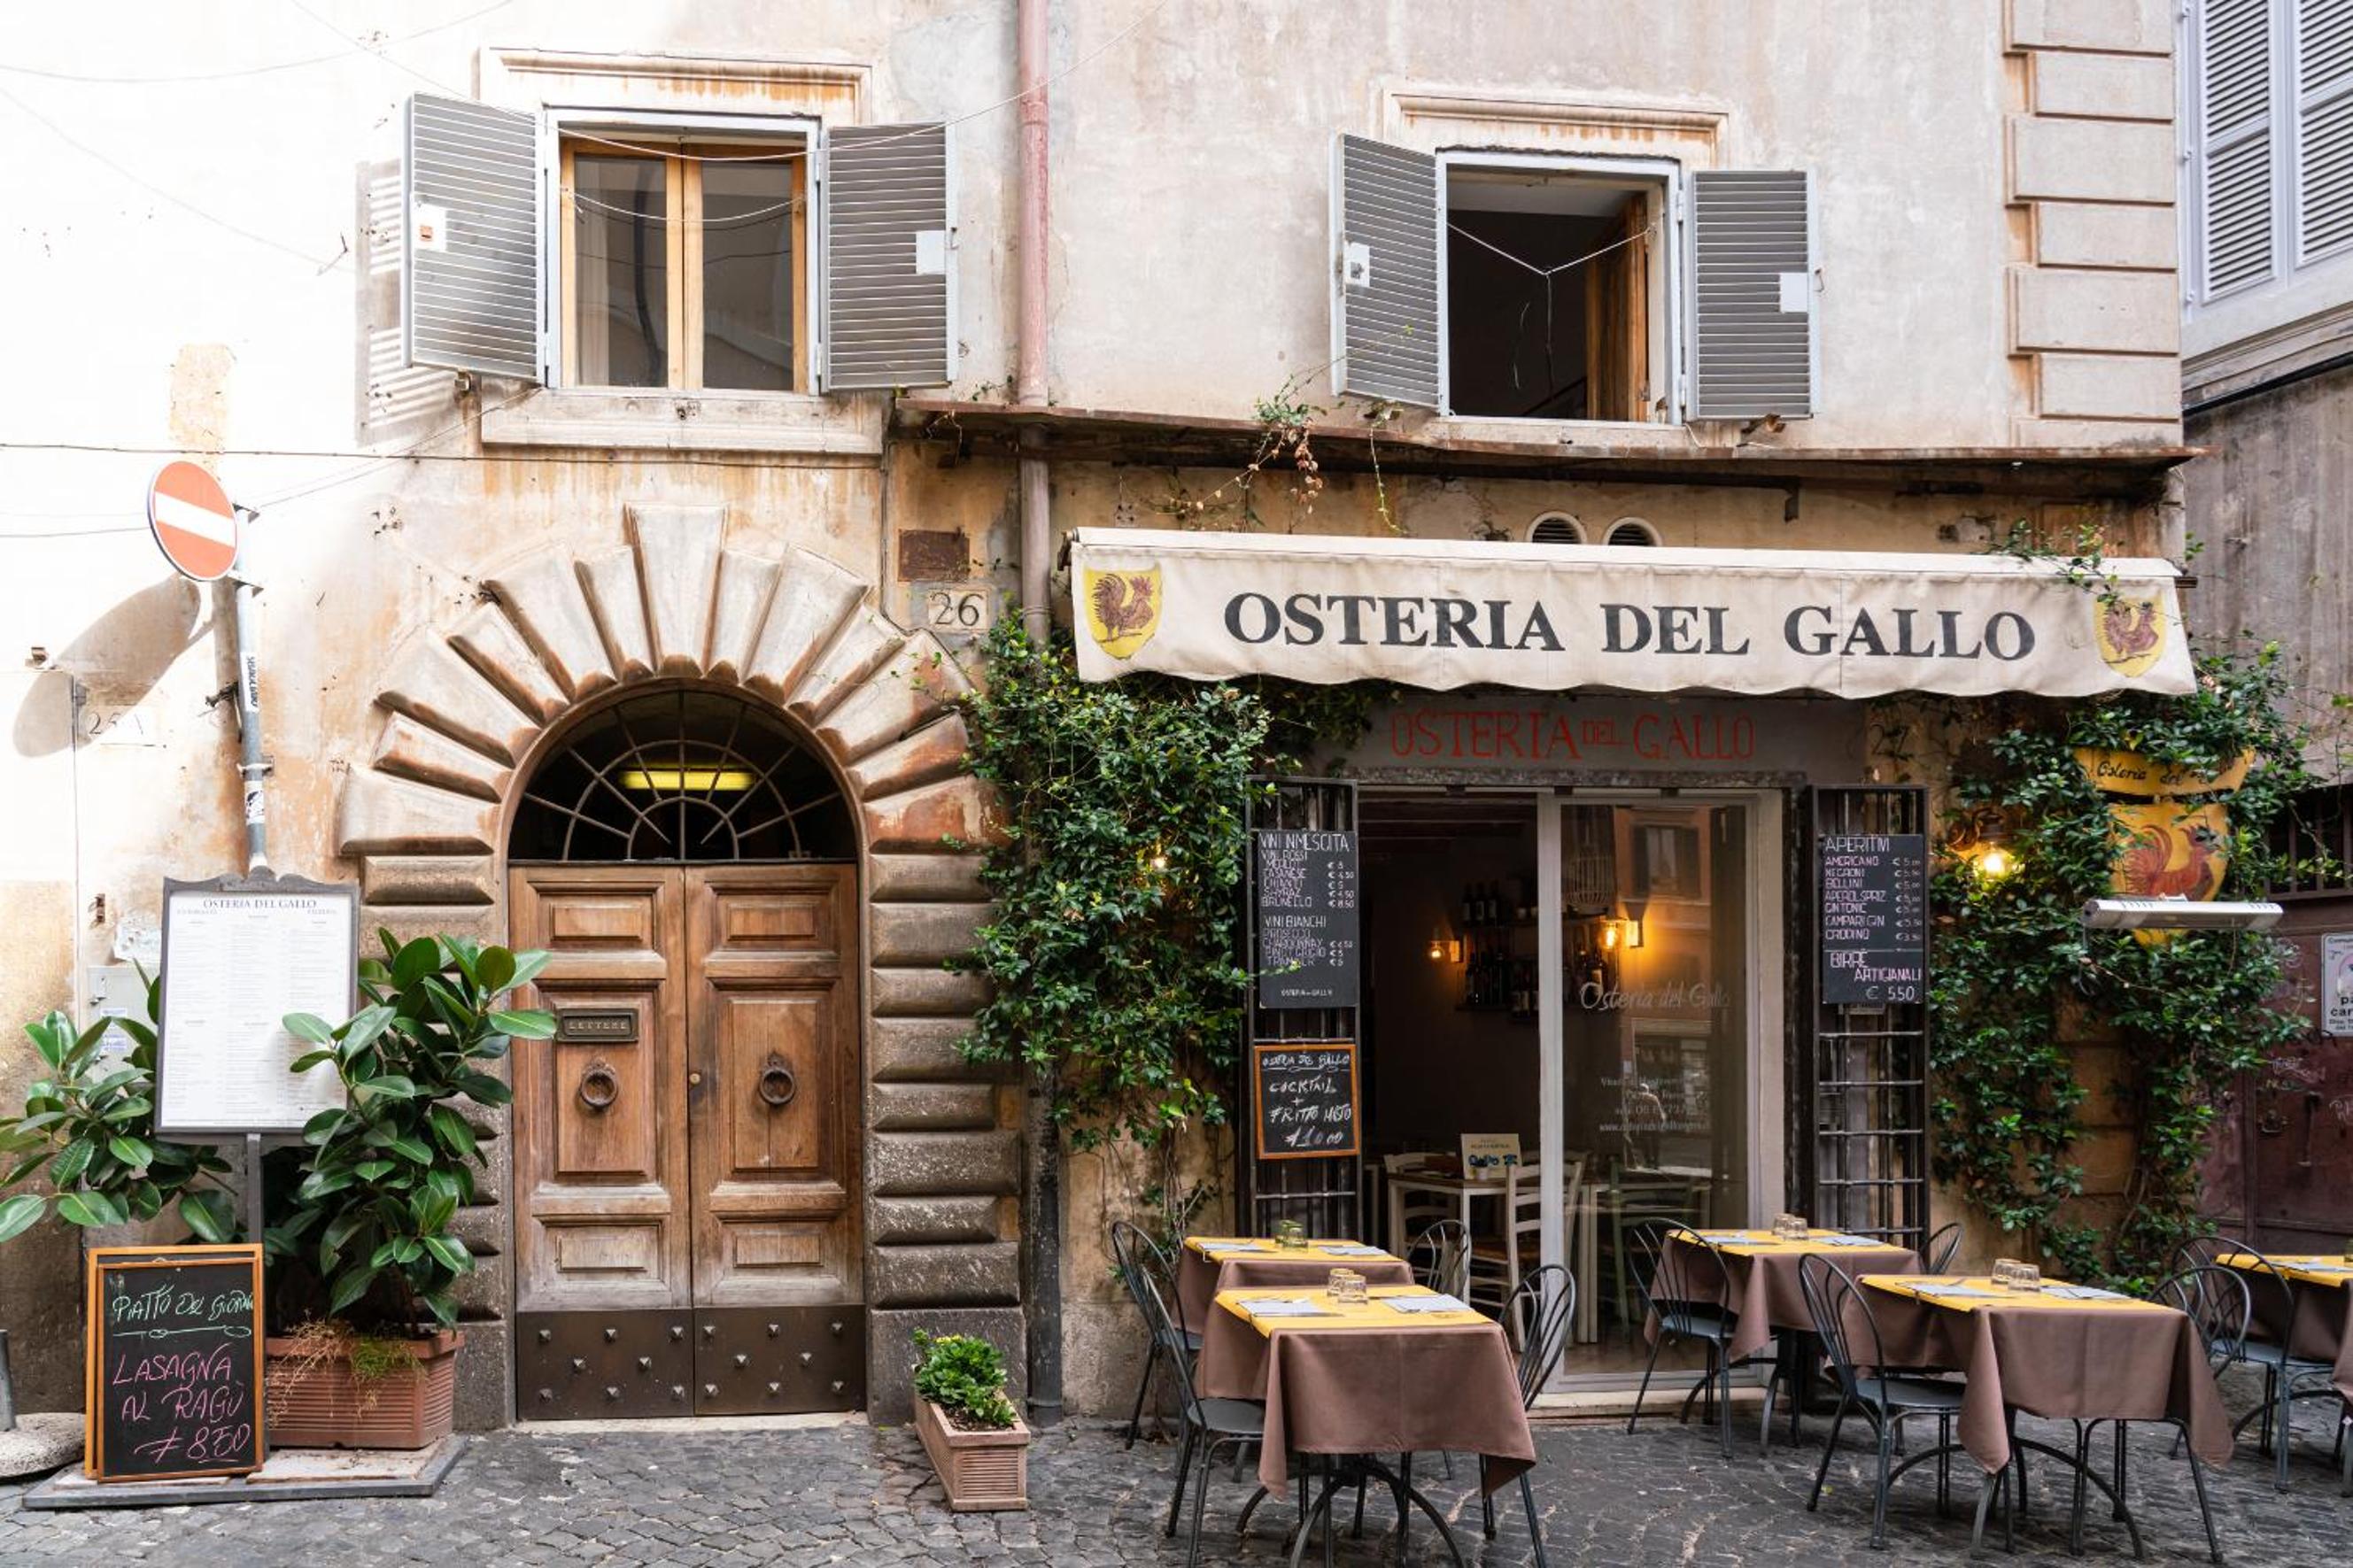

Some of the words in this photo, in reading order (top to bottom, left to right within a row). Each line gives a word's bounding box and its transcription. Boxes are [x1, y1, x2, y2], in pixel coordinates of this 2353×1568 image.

[929, 591, 985, 627] 26
[1224, 591, 1566, 653] OSTERIA
[1601, 603, 1750, 656] DEL
[1784, 605, 2036, 662] GALLO
[1390, 708, 1583, 761] OSTERIA
[1582, 719, 1617, 745] DEL
[1633, 714, 1755, 761] GALLO
[1824, 855, 1879, 867] AMERICANO
[203, 899, 251, 909] OSTERIA
[254, 899, 276, 909] DEL
[278, 899, 318, 910] GALLO
[1285, 915, 1327, 928] BIANCHI
[1579, 981, 1654, 1011] Osteria
[568, 1021, 628, 1031] LETTERE
[1268, 1074, 1337, 1093] COCKTAIL
[1268, 1105, 1320, 1124] FRITTO
[112, 1284, 174, 1323] PIATTO
[112, 1342, 235, 1387] LASAGNA
[121, 1390, 152, 1424] AL
